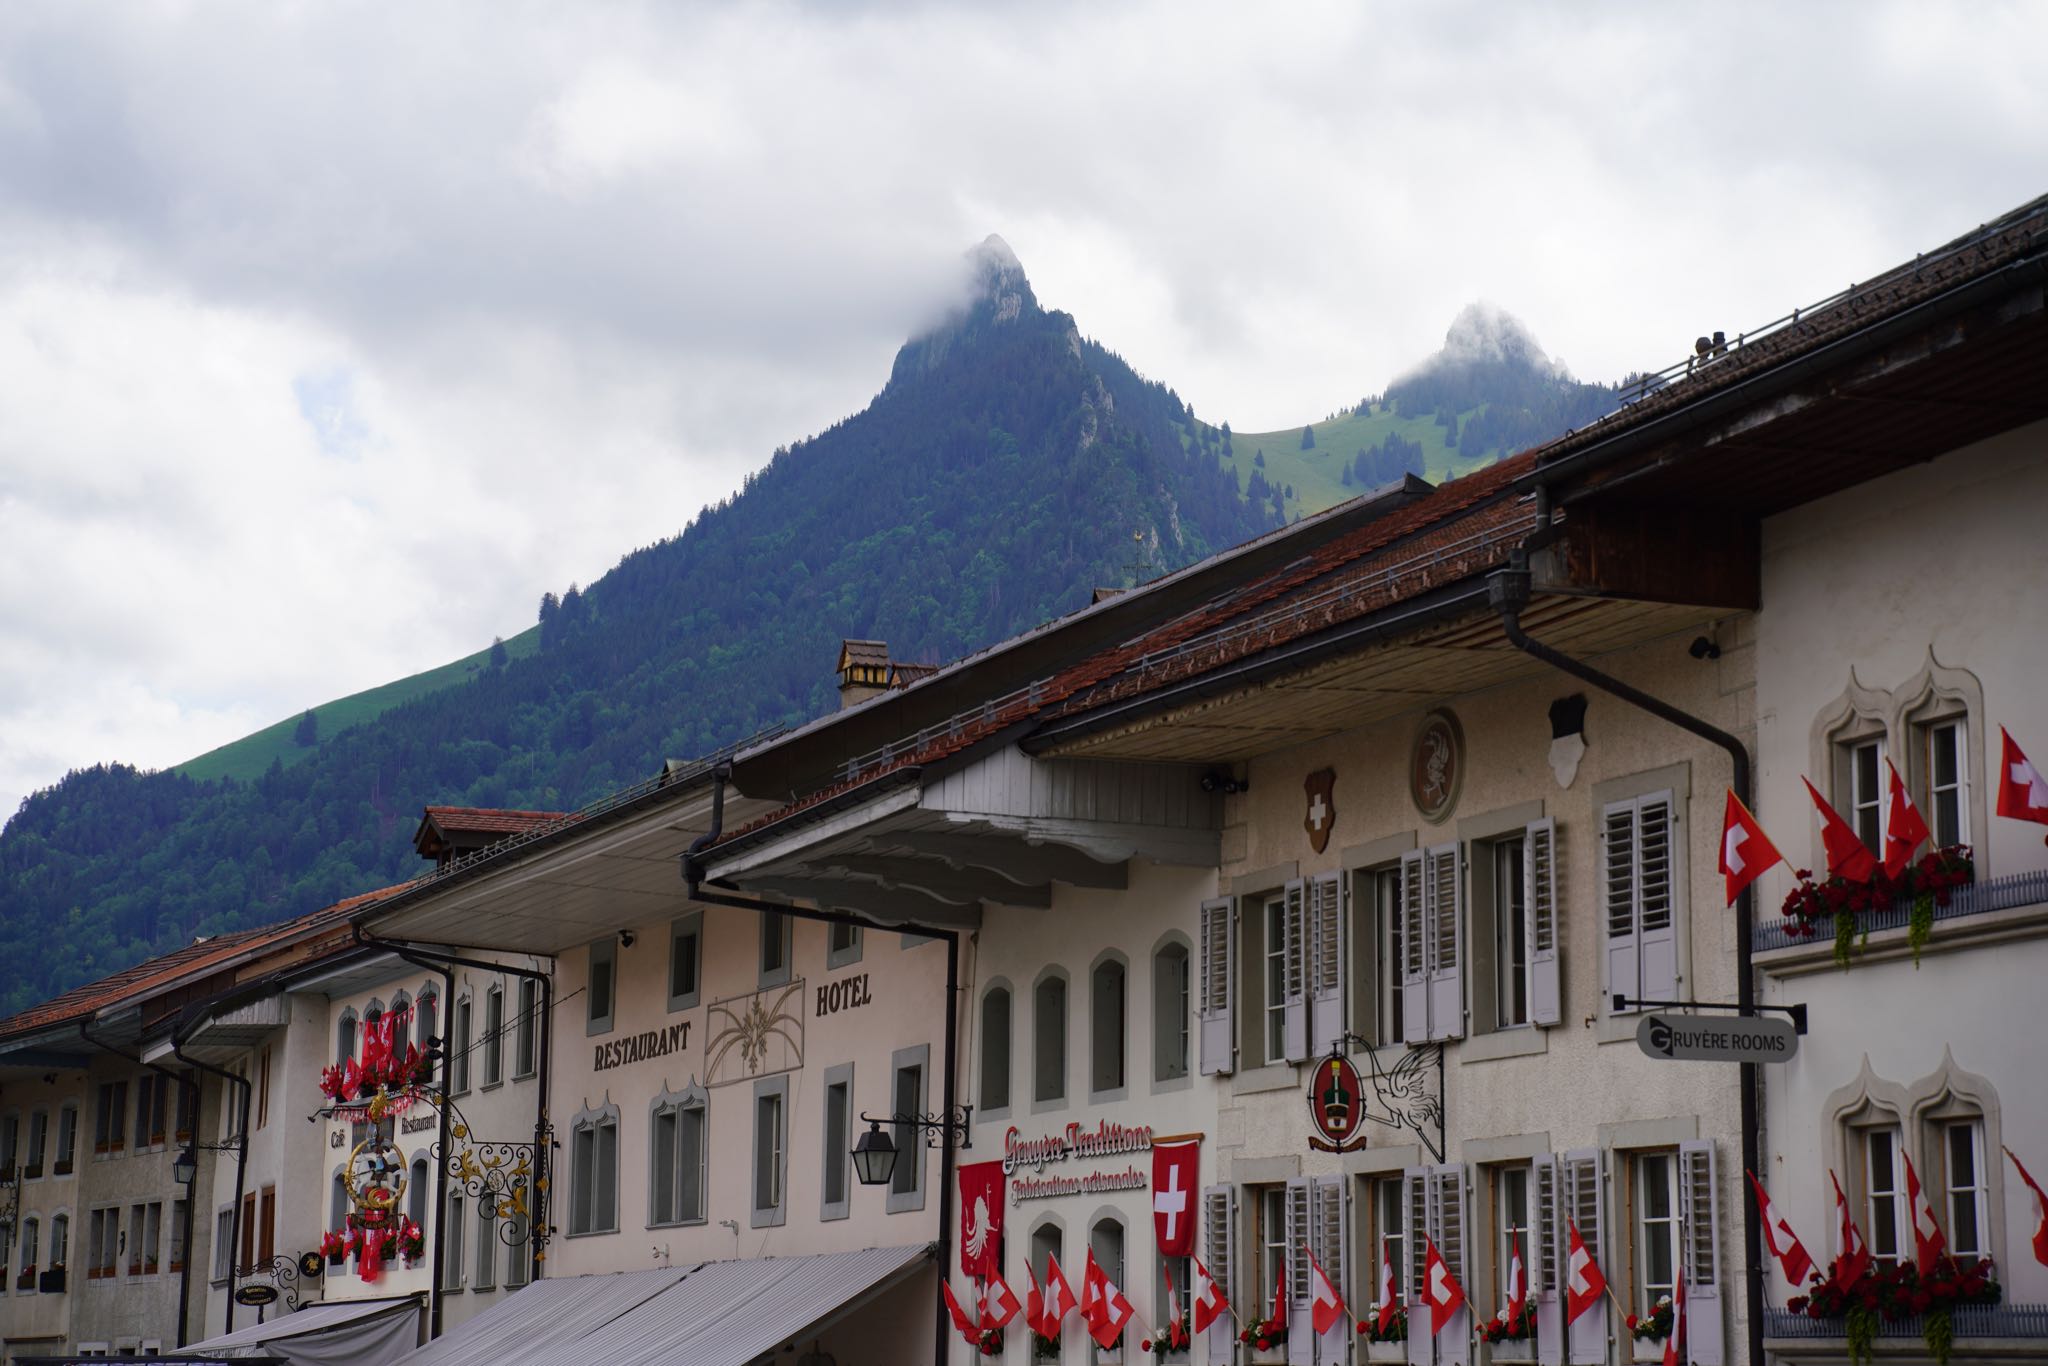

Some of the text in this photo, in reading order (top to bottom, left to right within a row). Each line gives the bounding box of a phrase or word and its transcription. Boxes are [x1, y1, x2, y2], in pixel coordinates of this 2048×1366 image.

[815, 973, 872, 1017] HOTEL
[593, 1021, 691, 1072] RESTAURANT
[1732, 1033, 1786, 1052] ROOMS
[401, 1111, 436, 1136] Restaurant
[1002, 1118, 1152, 1175] Gruyère Traditions
[1011, 1164, 1145, 1207] Fabrications artisanales
